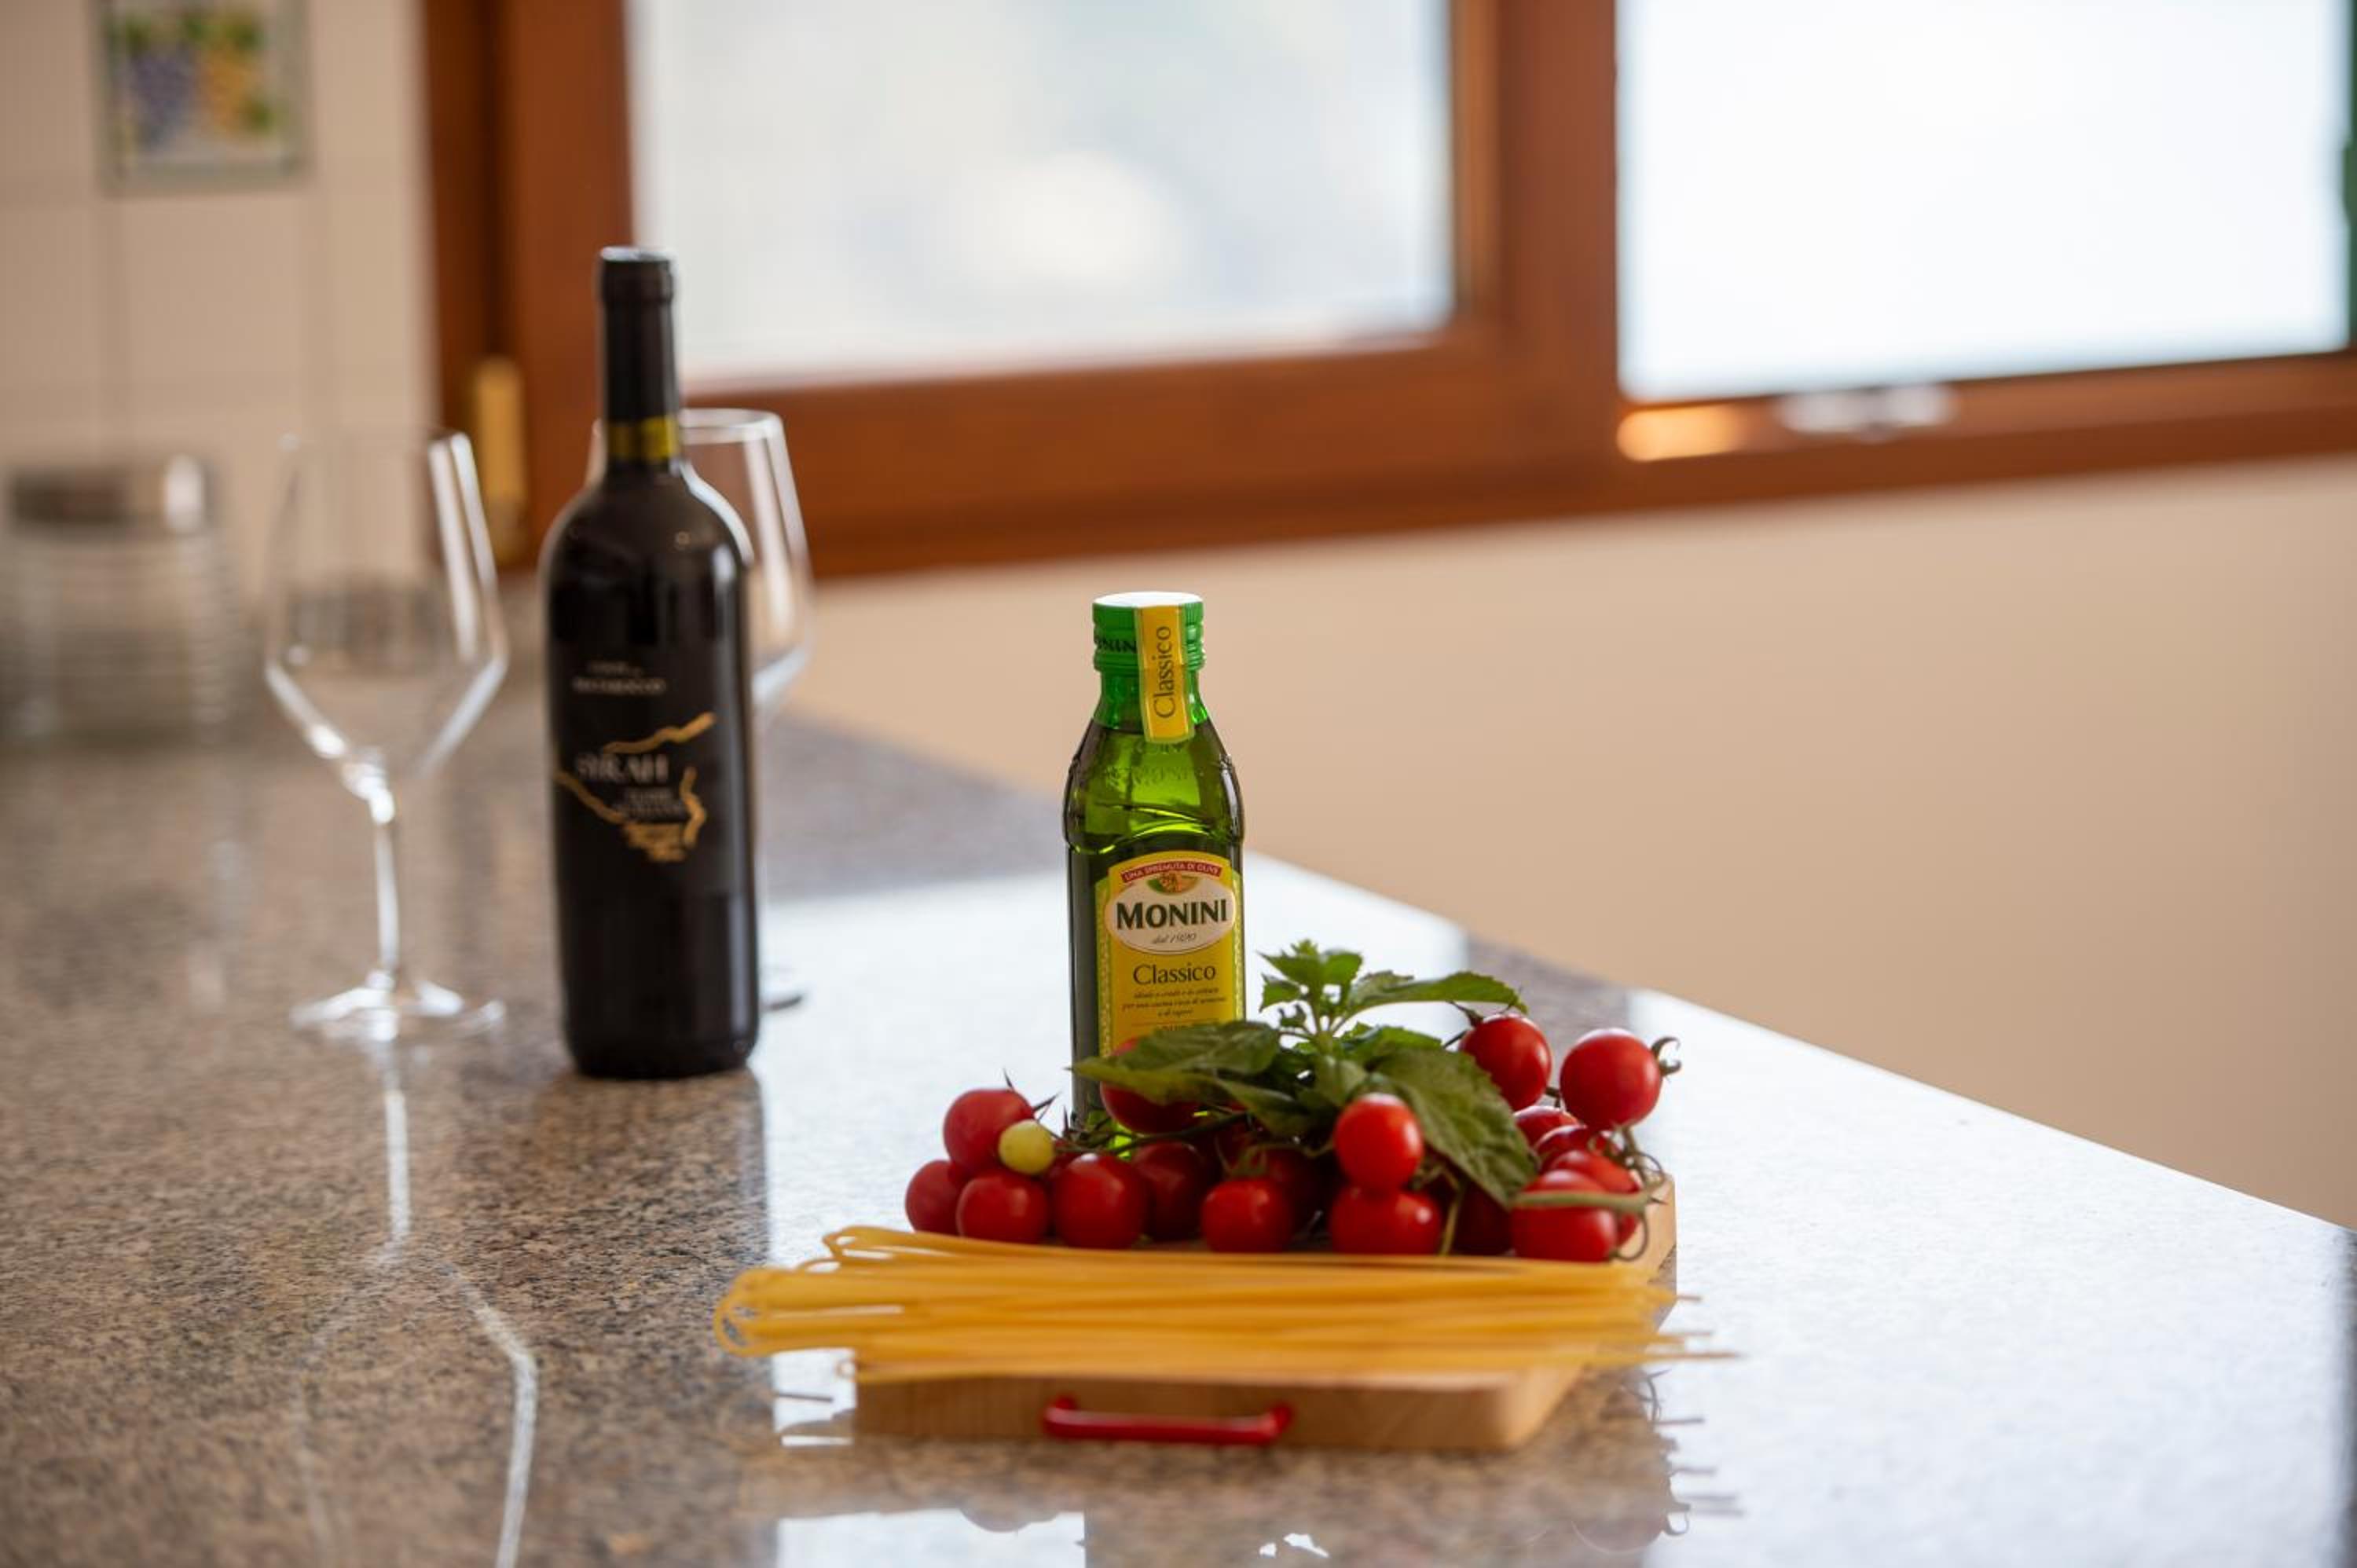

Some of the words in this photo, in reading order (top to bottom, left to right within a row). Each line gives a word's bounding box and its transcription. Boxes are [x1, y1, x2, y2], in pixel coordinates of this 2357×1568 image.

[1152, 626, 1176, 719] Classico
[1116, 899, 1226, 929] MONINI
[1133, 962, 1215, 984] Classico
